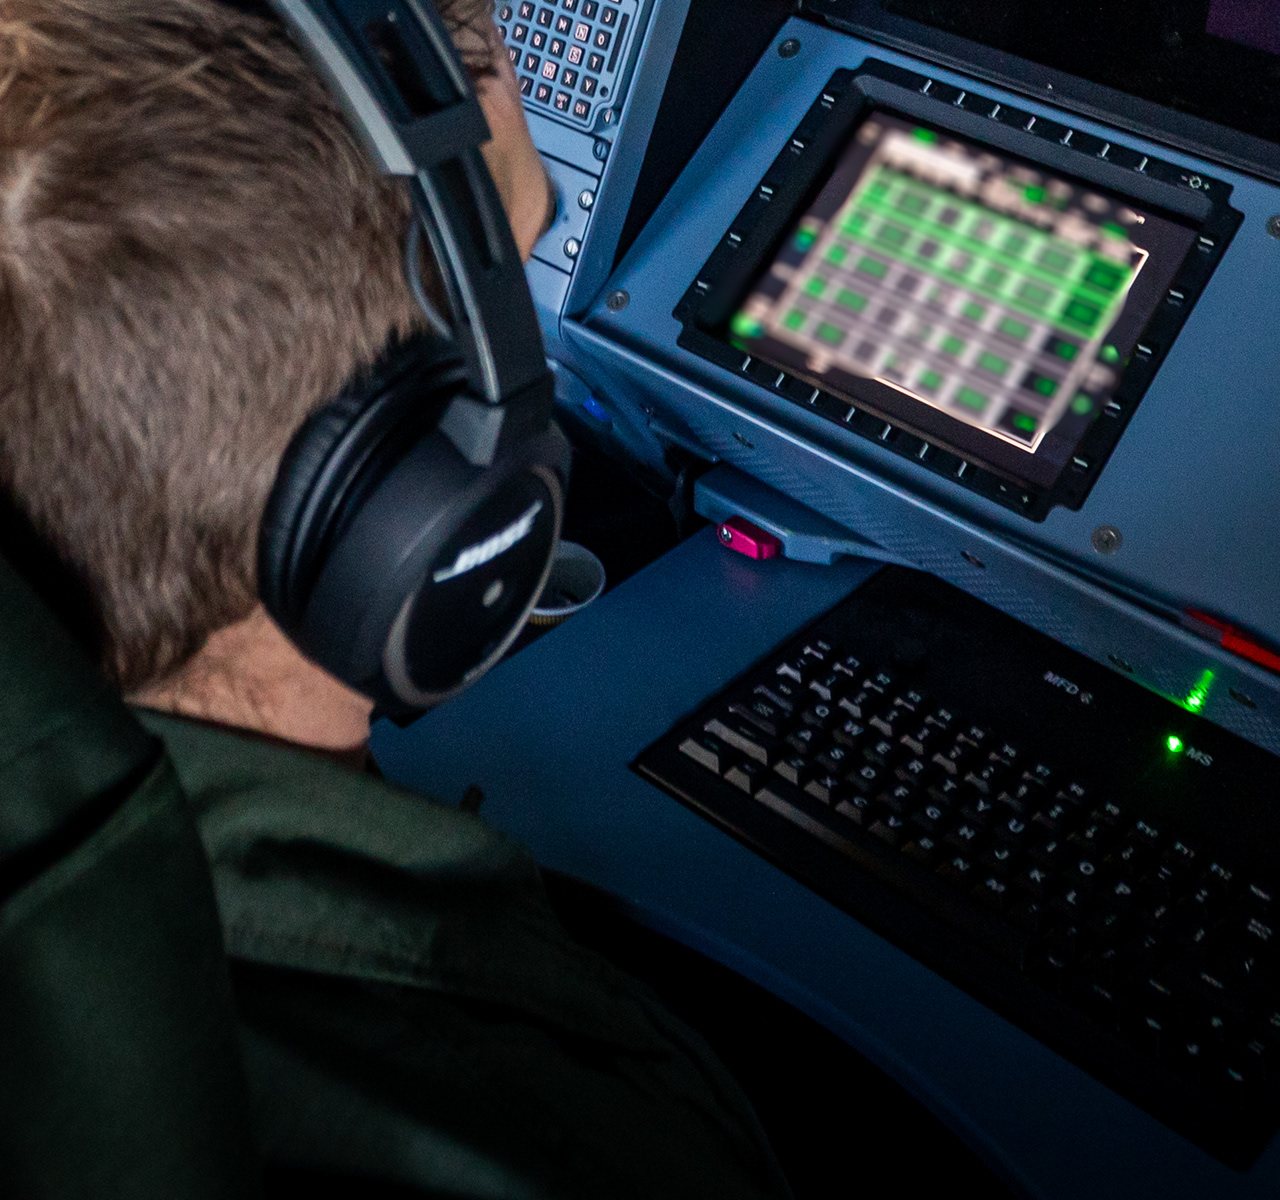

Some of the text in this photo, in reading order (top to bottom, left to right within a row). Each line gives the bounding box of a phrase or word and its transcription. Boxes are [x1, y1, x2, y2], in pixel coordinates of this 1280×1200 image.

[522, 4, 529, 16] K
[605, 11, 612, 22] J
[558, 18, 568, 31] M
[515, 26, 522, 38] P
[597, 33, 605, 45] O
[552, 41, 560, 54] R
[528, 56, 535, 68] V
[592, 56, 598, 68] T
[564, 72, 572, 84] X
[585, 79, 592, 91] Y
[1008, 818, 1024, 834] U
[1079, 859, 1095, 876] O
